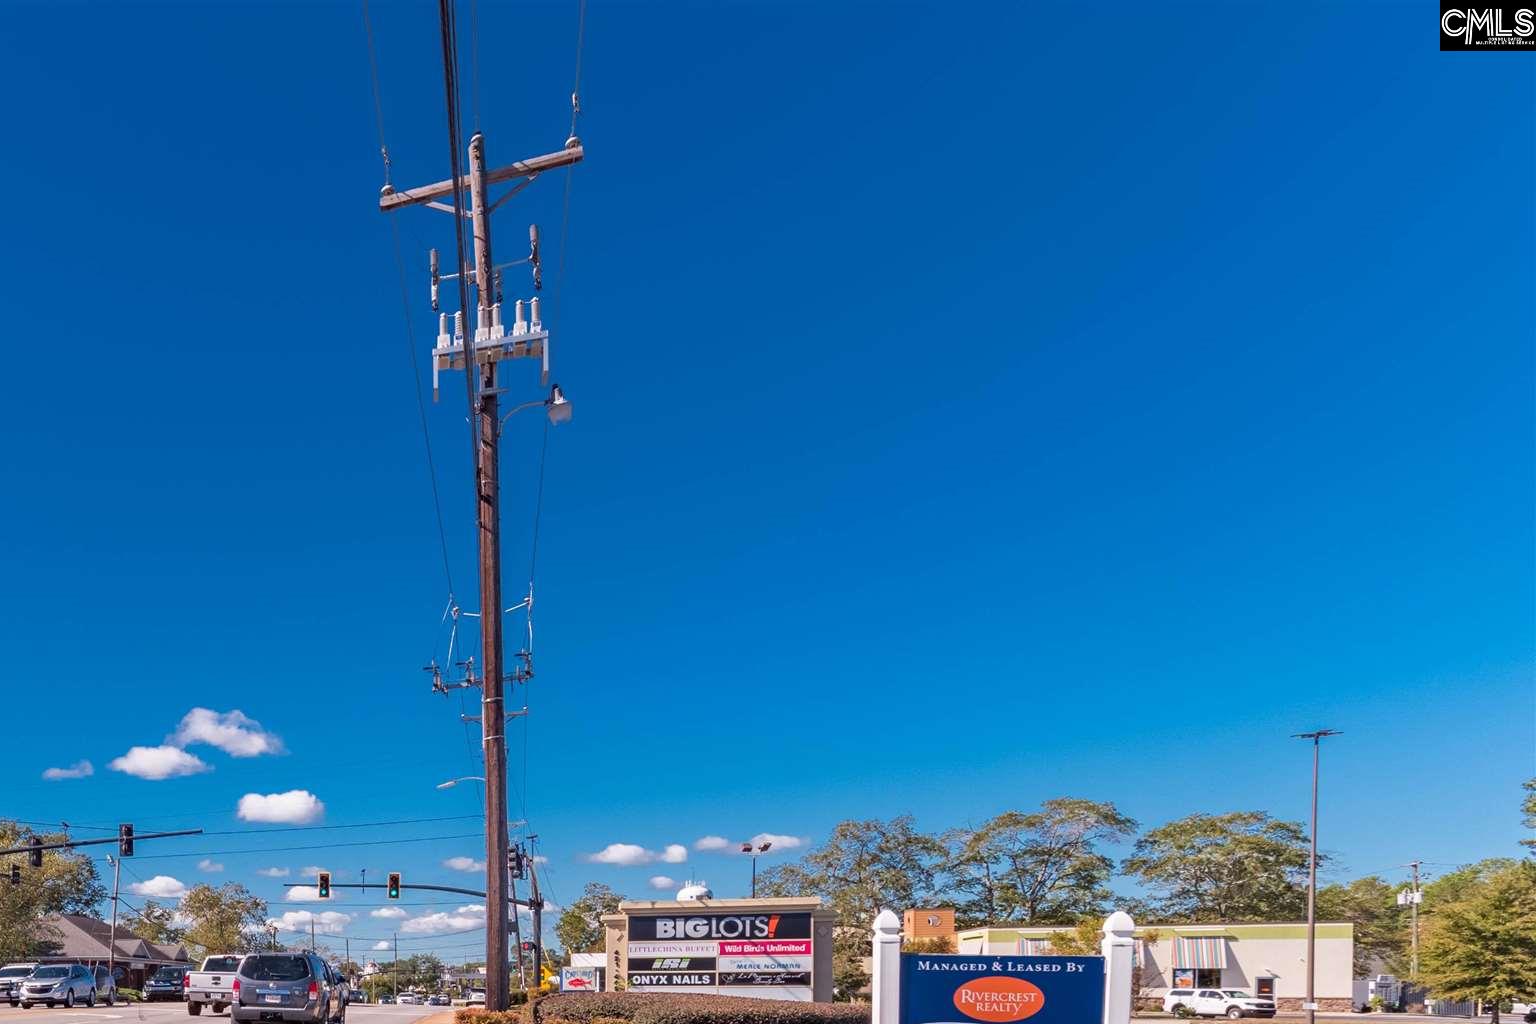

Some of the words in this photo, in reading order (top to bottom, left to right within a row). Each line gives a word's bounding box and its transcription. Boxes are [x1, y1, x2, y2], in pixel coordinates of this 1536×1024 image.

[724, 944, 742, 953] Wild
[743, 944, 765, 952] Birds
[766, 943, 806, 952] Unlimited
[991, 961, 1003, 972] &
[632, 975, 668, 985] ONYX
[672, 975, 711, 984] NAILS
[961, 989, 1038, 1004] RIVERCREST
[975, 1002, 1024, 1016] REALTY
